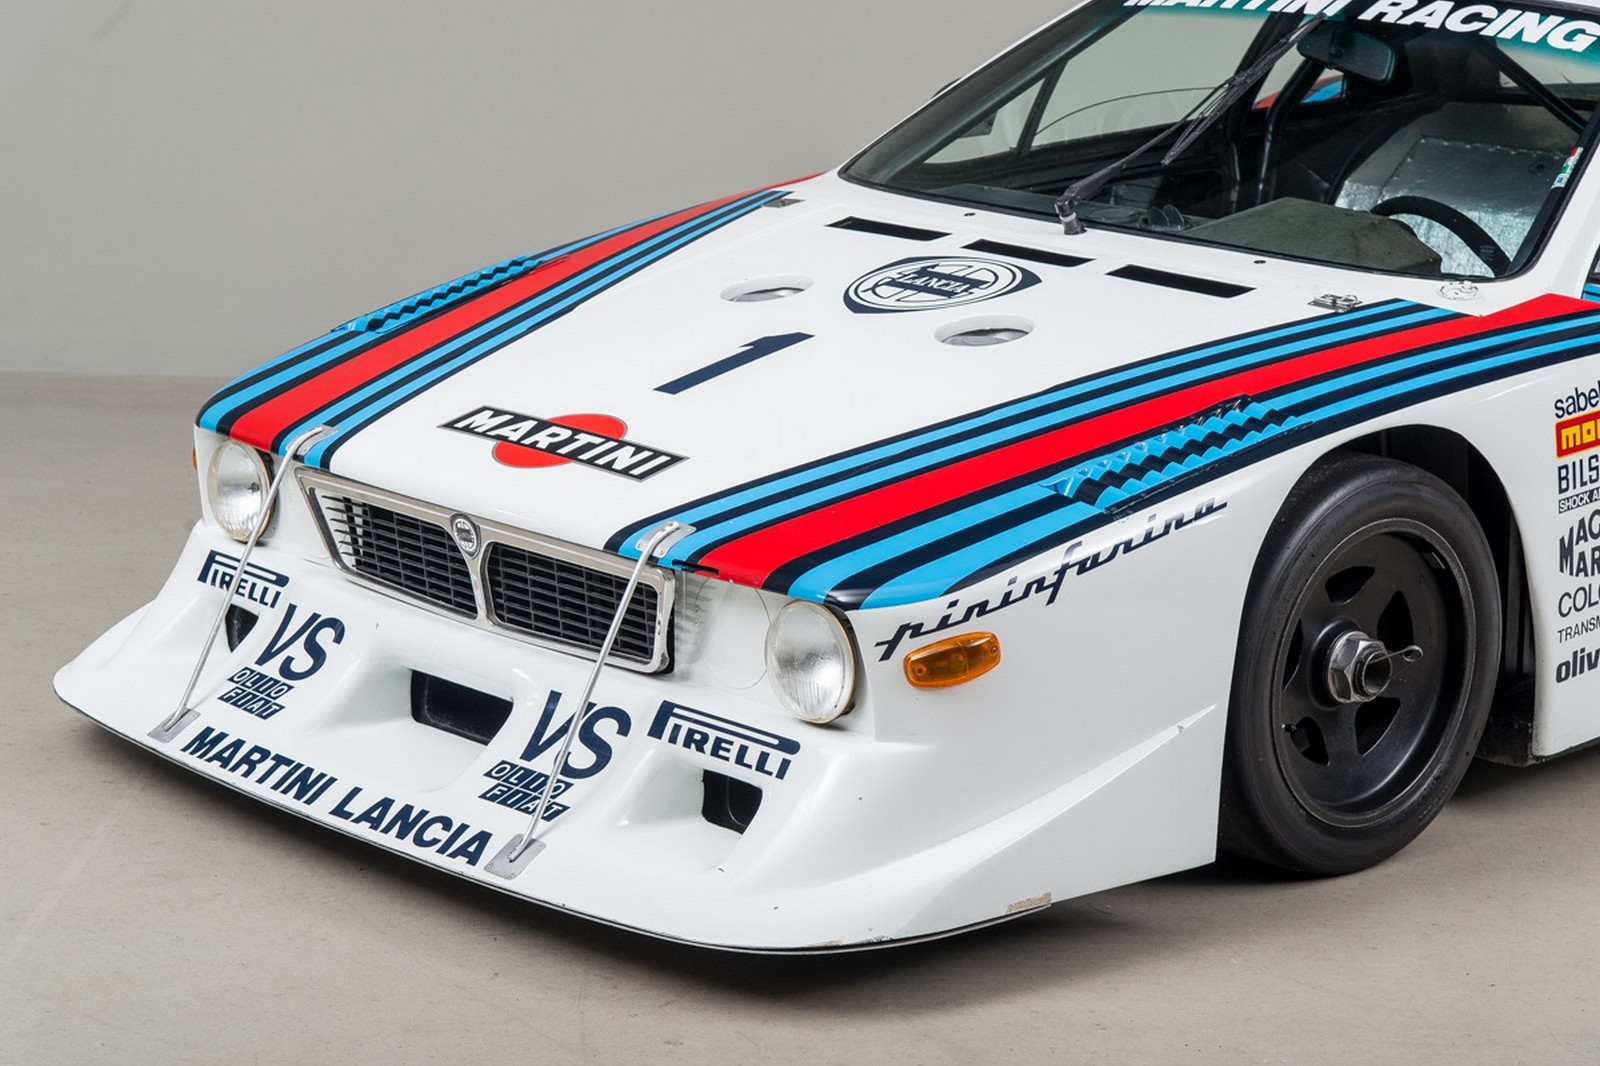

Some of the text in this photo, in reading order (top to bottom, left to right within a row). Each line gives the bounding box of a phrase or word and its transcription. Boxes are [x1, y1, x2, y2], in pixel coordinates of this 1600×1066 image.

[1357, 0, 1600, 53] RACING
[895, 271, 970, 294] LANCIA
[652, 331, 816, 395] 1
[453, 409, 672, 476] MARTINI
[1557, 454, 1600, 495] BILS
[1559, 492, 1590, 512] SHOCK
[196, 549, 290, 609] PIRELLI
[874, 497, 1227, 662] pininfarina
[1558, 583, 1600, 618] COL
[254, 602, 346, 682] VS
[222, 688, 281, 717] FIAT
[232, 669, 289, 698] OLIO
[519, 689, 632, 780] VS
[646, 699, 801, 780] PIRELLI
[180, 726, 493, 867] MARTINI LANCIA
[486, 785, 564, 818] FIAT
